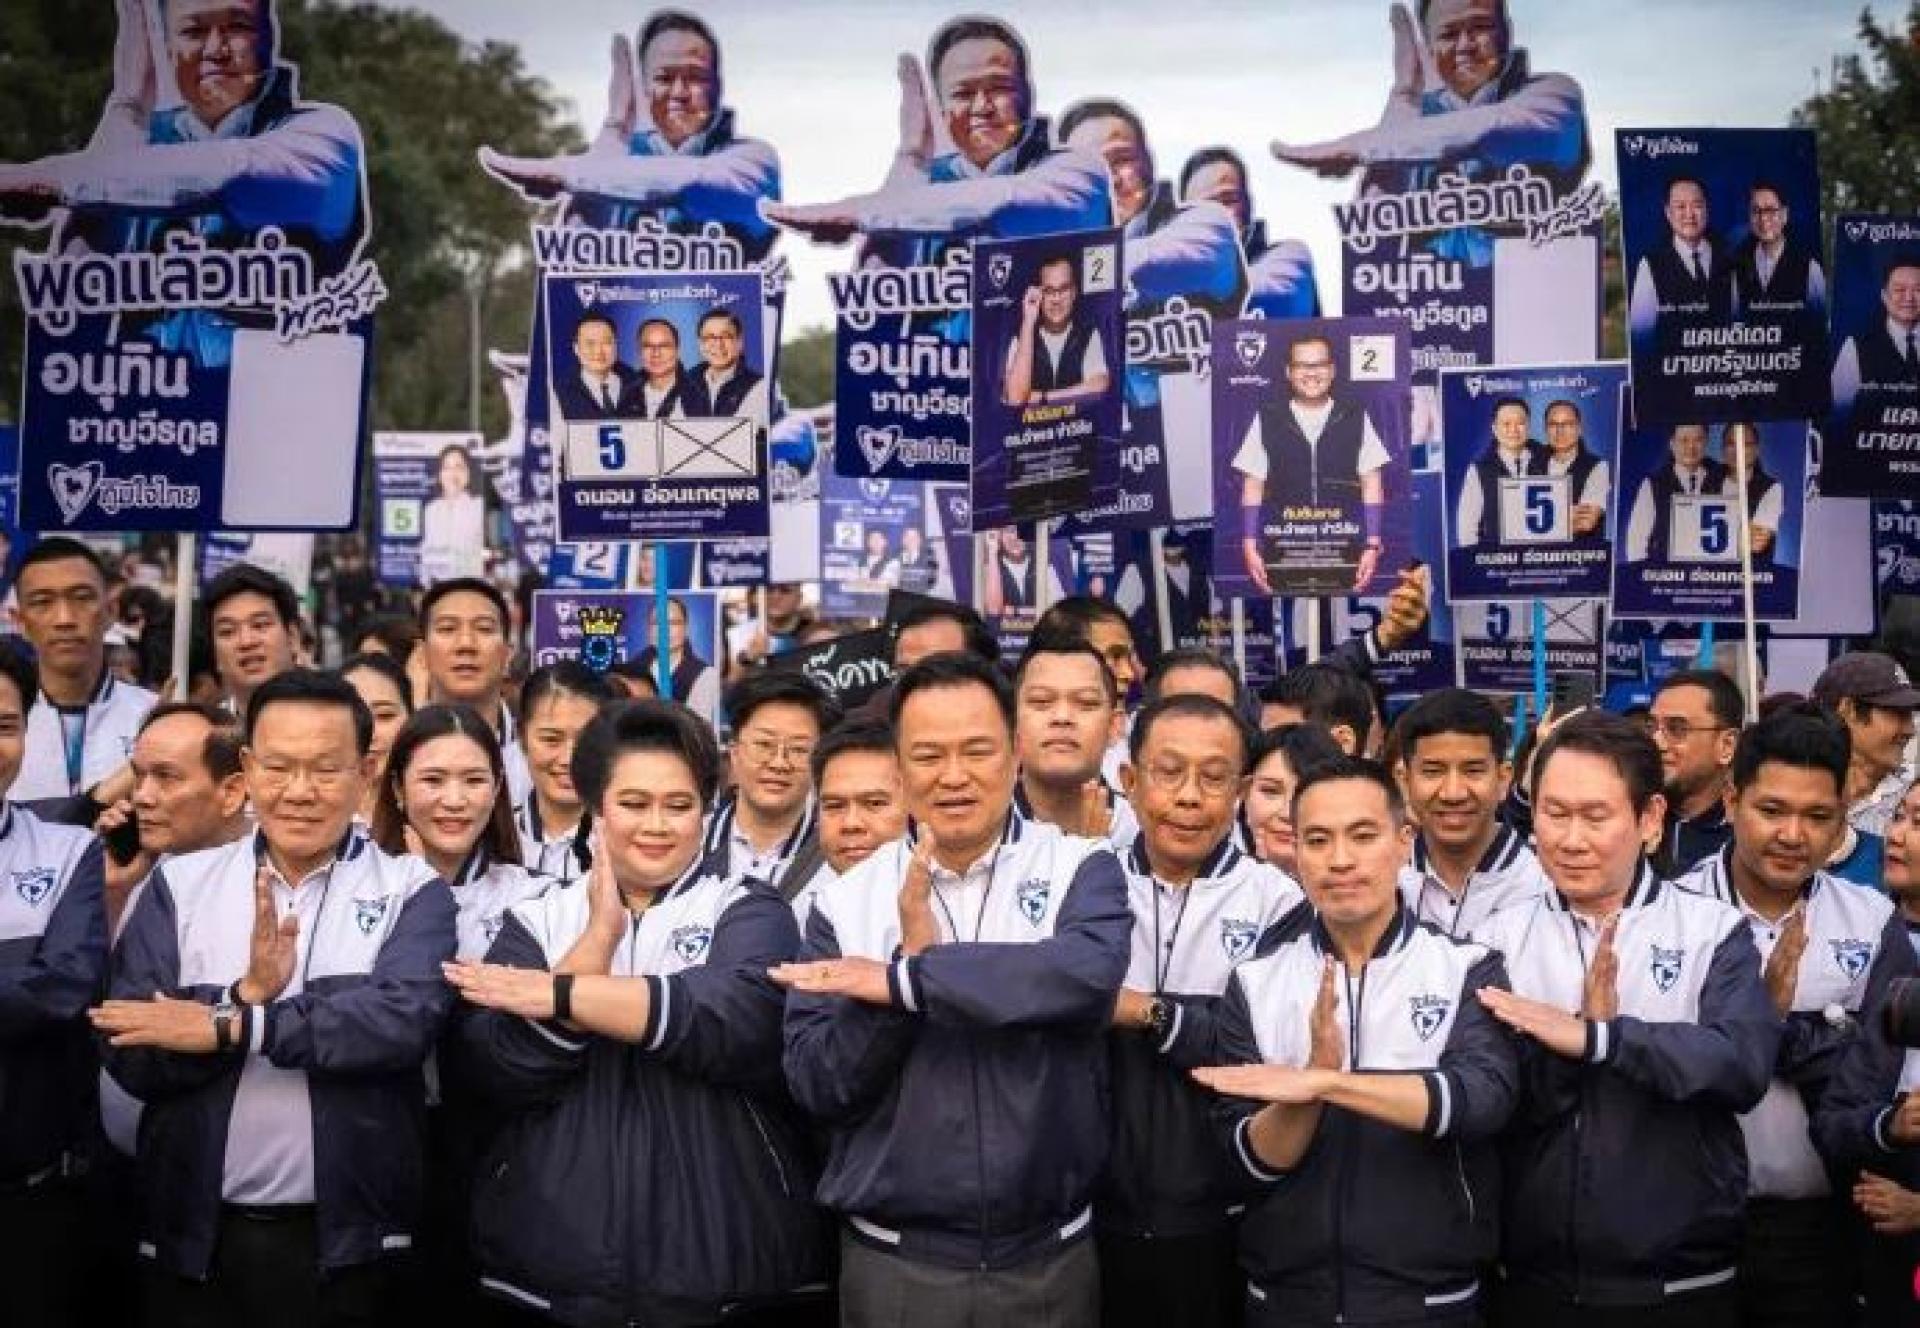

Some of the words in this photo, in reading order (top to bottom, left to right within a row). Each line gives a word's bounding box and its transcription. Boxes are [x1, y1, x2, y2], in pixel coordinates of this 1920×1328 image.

[1333, 164, 1553, 252] พูดแล้วทำ
[20, 227, 312, 335] พูดแล้วทำ
[1090, 257, 1105, 282] 2
[1353, 254, 1464, 304] อนุทิน
[41, 342, 190, 411] อนุทิน
[848, 336, 972, 389] อนุทิน
[1360, 349, 1380, 373] 2
[1662, 345, 1802, 379] นายกรัฐมนตรี
[67, 409, 219, 456] ชาญวีรกูล
[1881, 406, 1920, 424] แค
[598, 424, 626, 470] 5
[96, 474, 201, 516] ภูมิใจไทย
[1525, 484, 1556, 535] 5
[392, 506, 413, 532] 5
[1702, 504, 1730, 555] 5
[1485, 602, 1510, 644] 5
